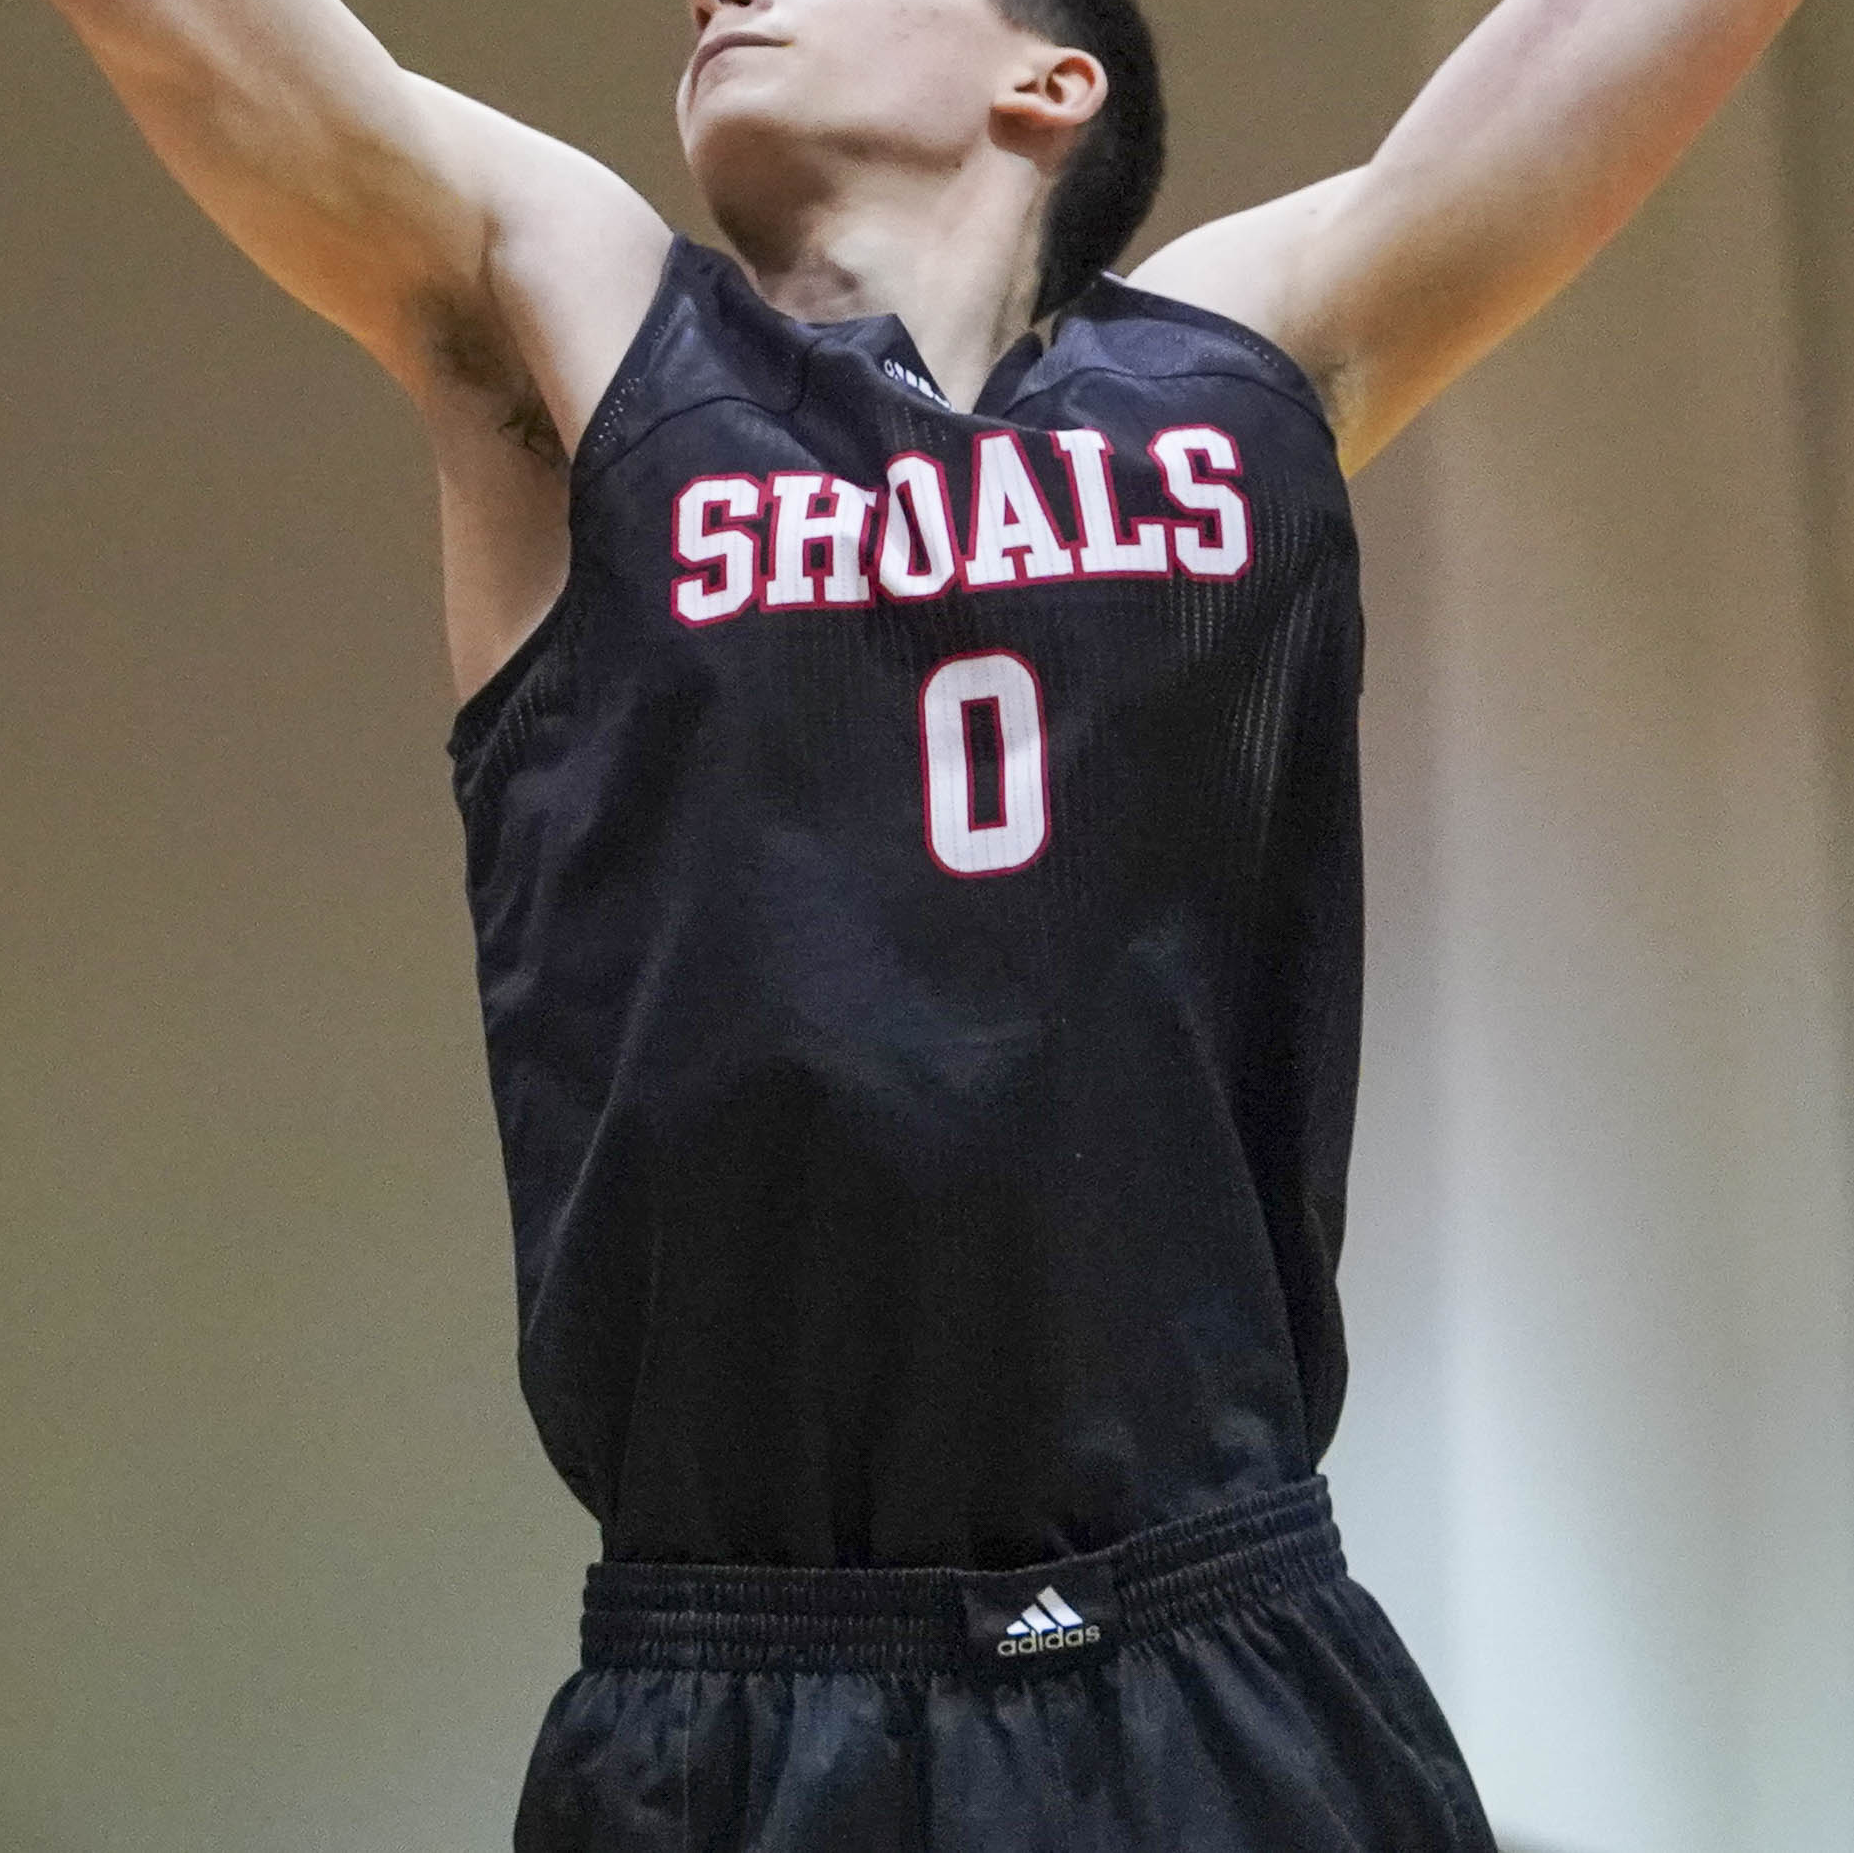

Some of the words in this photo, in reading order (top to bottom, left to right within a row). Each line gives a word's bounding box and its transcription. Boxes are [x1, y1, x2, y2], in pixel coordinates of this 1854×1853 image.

[672, 425, 1253, 628] SHOALS
[920, 650, 1050, 879] 0
[997, 1624, 1101, 1656] adidas
